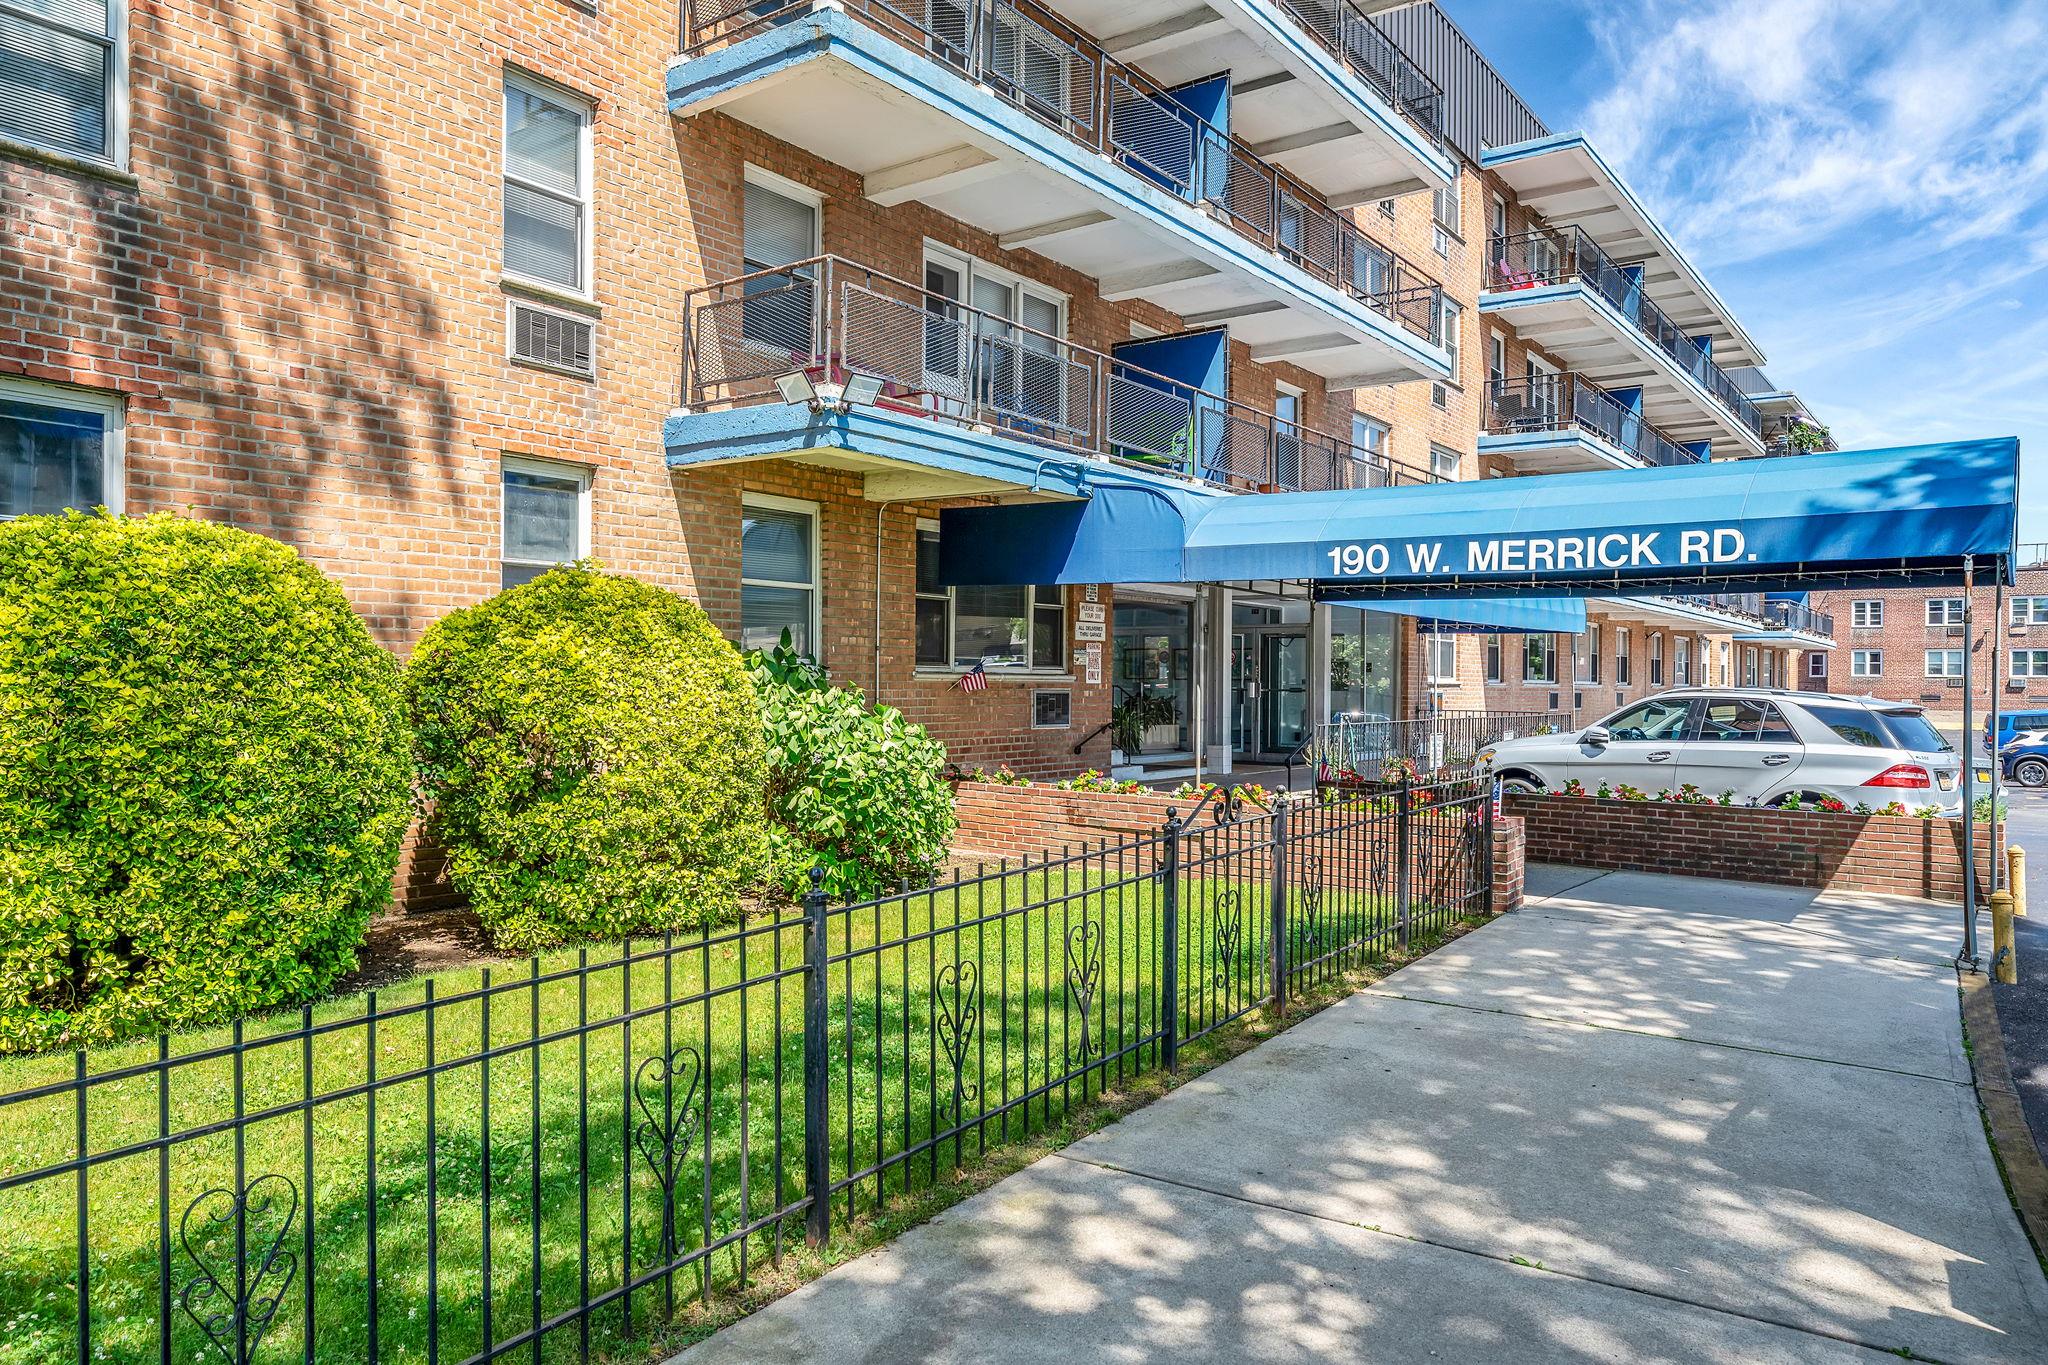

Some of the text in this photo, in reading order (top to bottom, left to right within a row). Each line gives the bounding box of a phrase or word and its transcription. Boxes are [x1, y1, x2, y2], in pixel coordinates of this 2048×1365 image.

[1327, 528, 1757, 576] 190 W. MERRICK RD.
[1081, 604, 1095, 612] PLEASE
